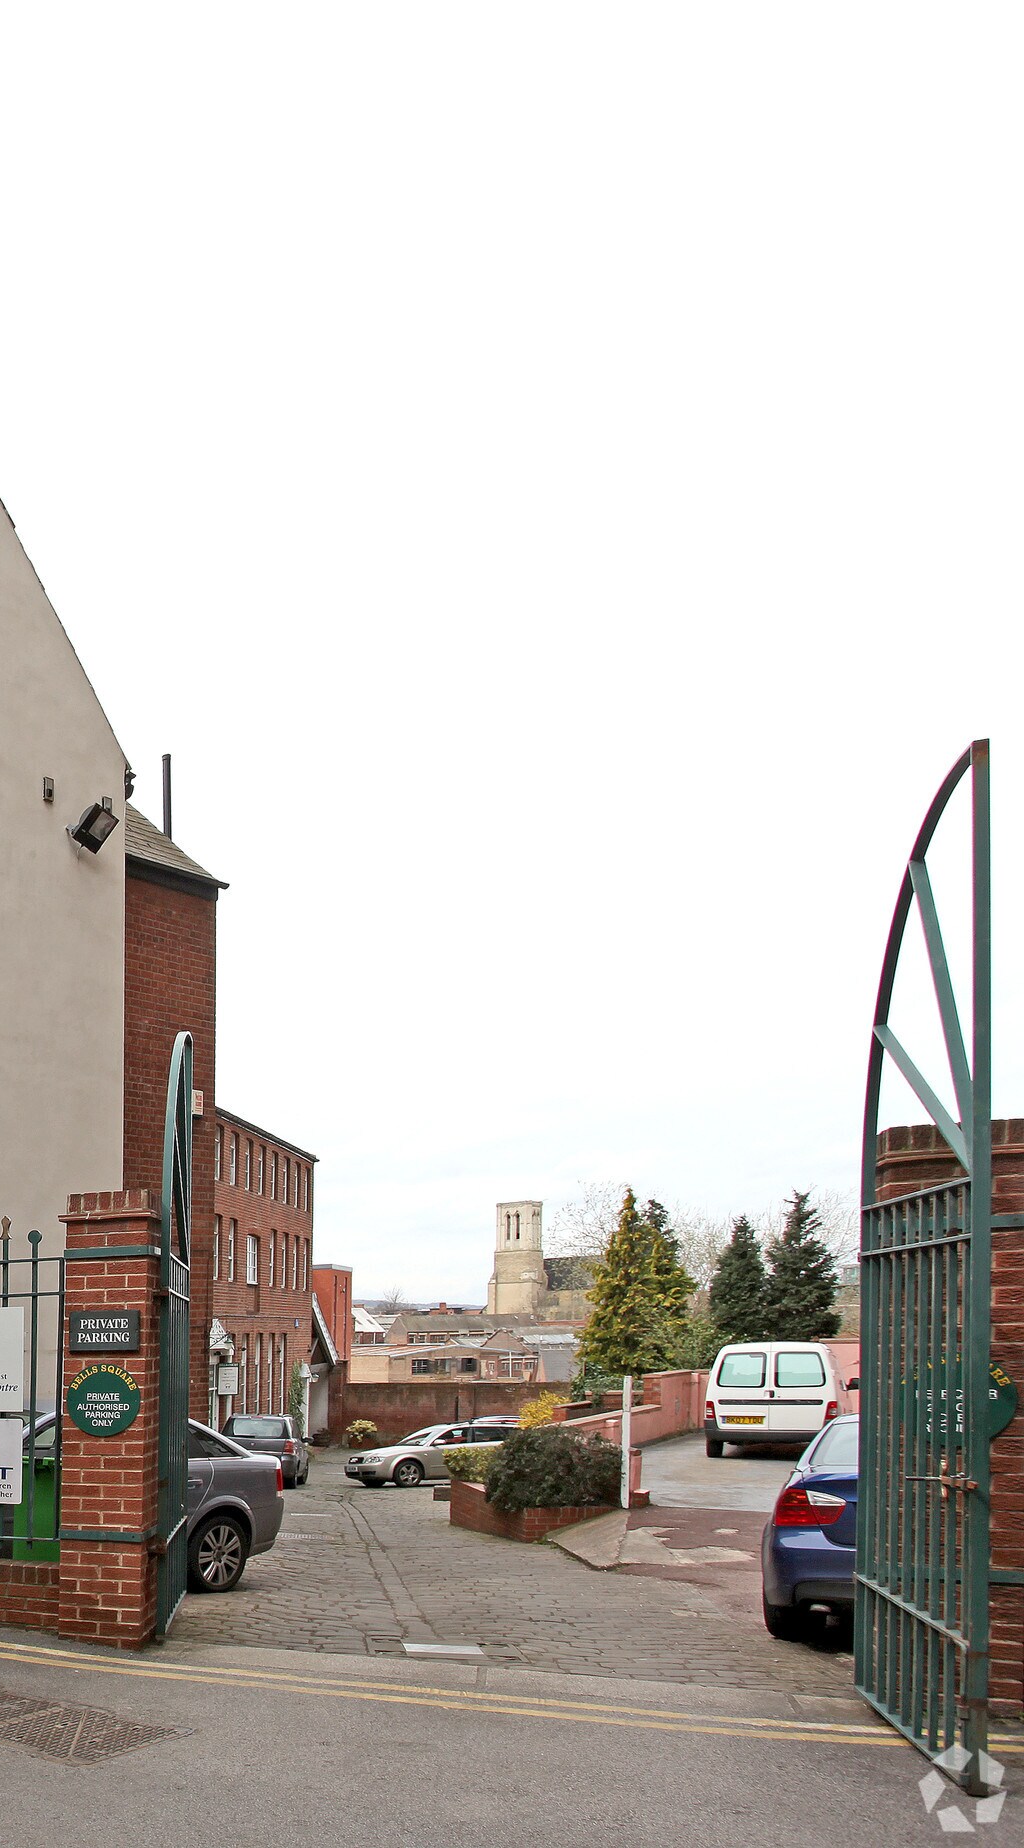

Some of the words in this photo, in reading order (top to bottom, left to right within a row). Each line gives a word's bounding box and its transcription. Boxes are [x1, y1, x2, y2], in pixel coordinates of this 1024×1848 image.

[80, 1318, 129, 1330] PRIVATE
[77, 1332, 130, 1343] PARKING
[70, 1365, 98, 1391] BELLS
[101, 1364, 137, 1391] SQUARE
[86, 1392, 120, 1400] PRIVATE
[76, 1403, 130, 1411] AUTHORISED
[85, 1411, 121, 1419] PARKING
[91, 1419, 114, 1427] ONLY
